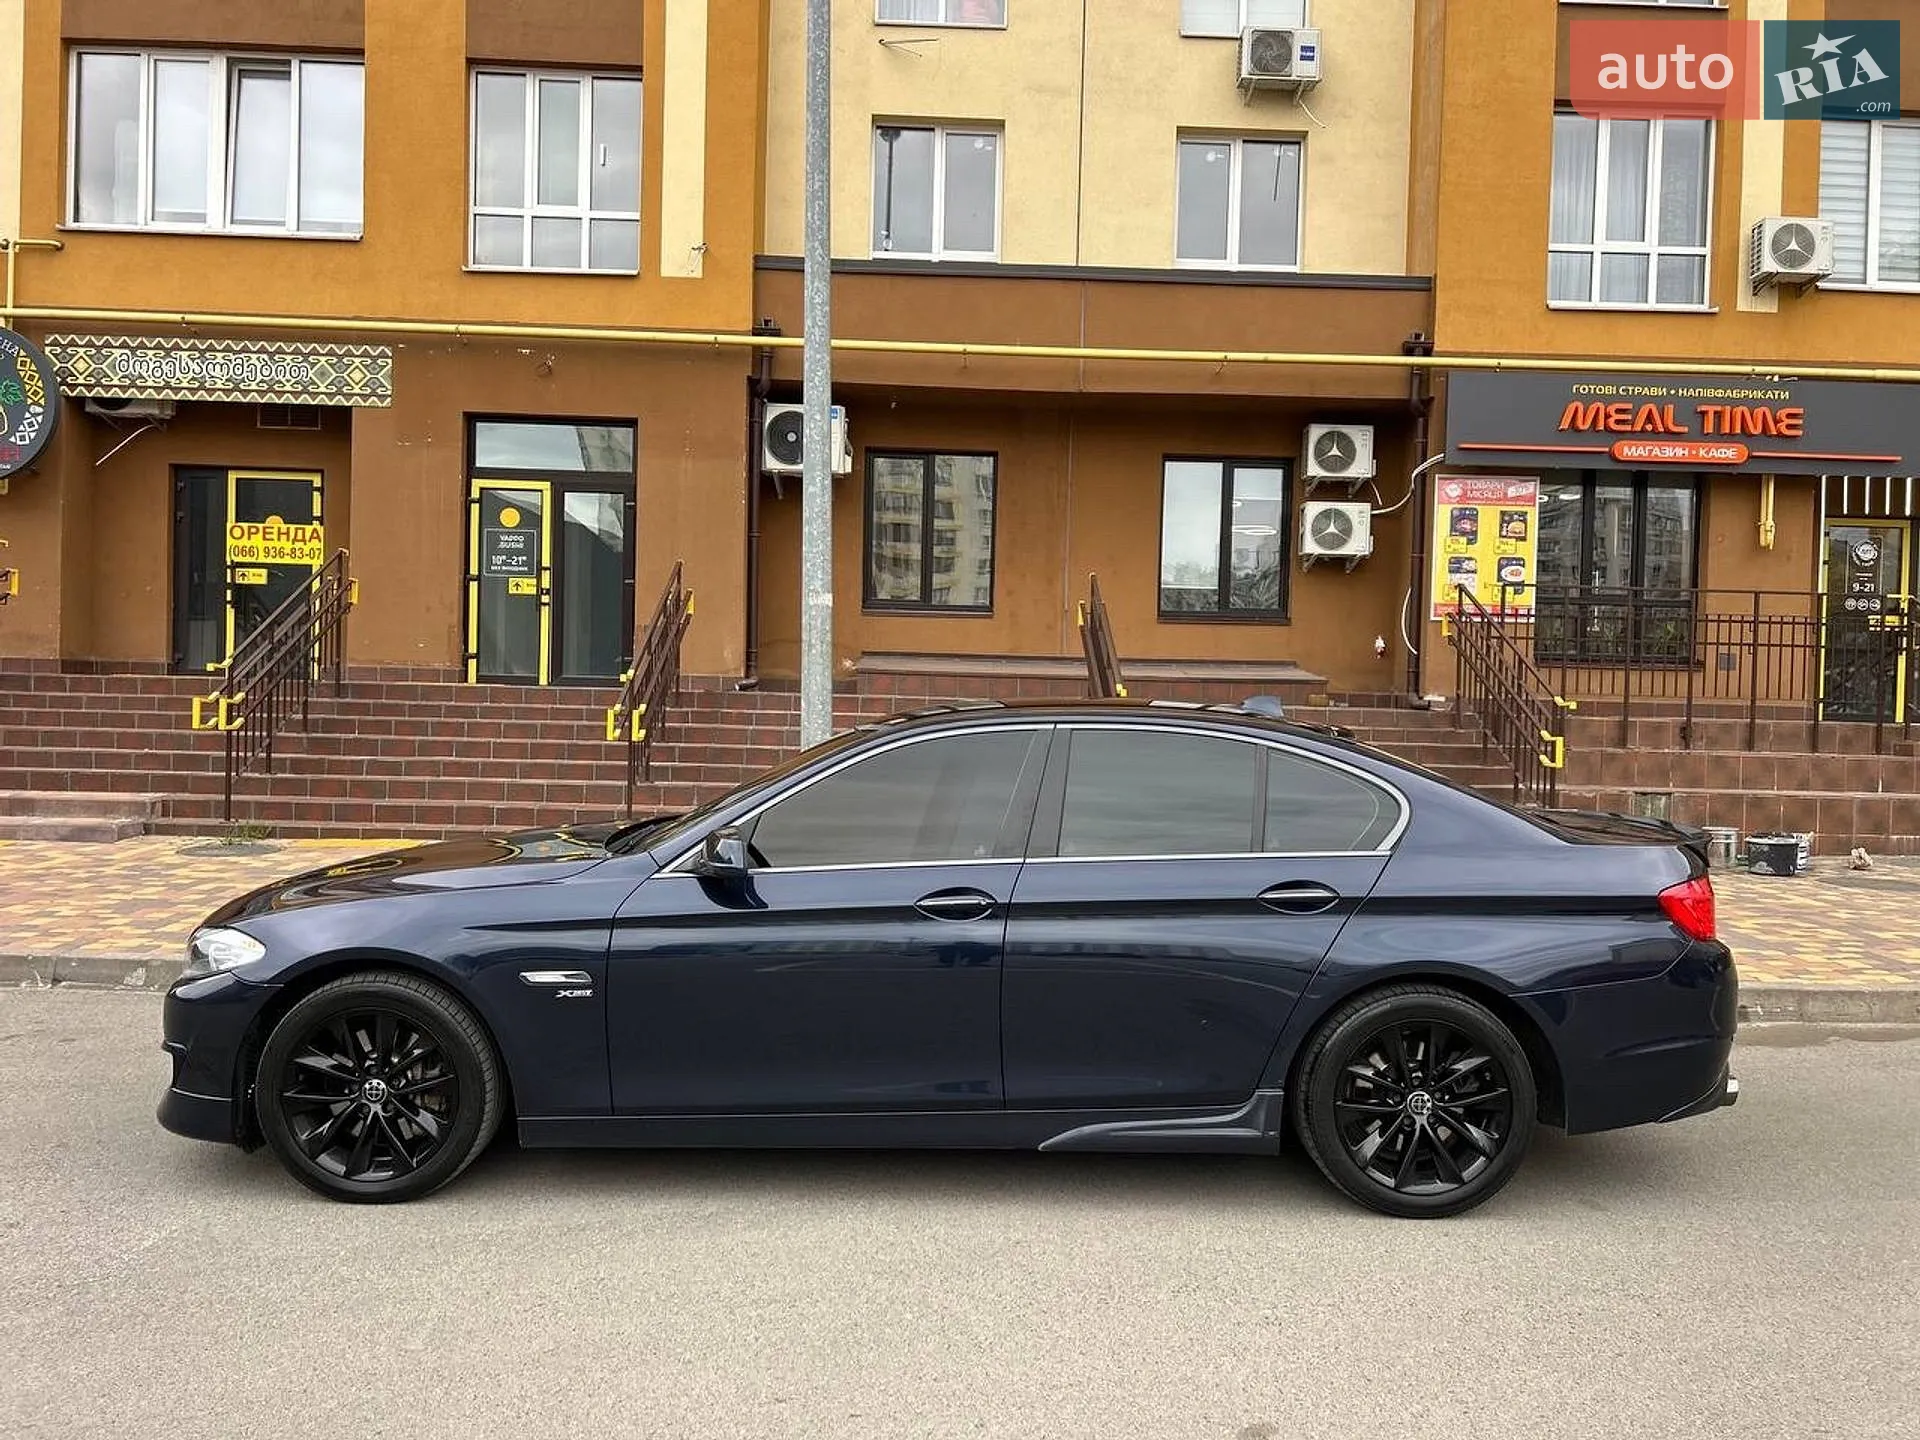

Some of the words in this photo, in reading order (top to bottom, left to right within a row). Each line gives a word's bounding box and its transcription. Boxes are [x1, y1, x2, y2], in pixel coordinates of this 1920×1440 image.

[1572, 384, 1617, 395] ГОТОВІ
[1619, 385, 1667, 396] СТРАВИ
[1679, 388, 1790, 400] НАПІВФАБРИКАТИ
[1558, 400, 1689, 434] MEAL
[1696, 404, 1805, 437] TIME
[1623, 445, 1689, 457] МАГАЗИН
[1699, 447, 1738, 459] КАФЕ
[229, 525, 321, 545] ОРЕНДА
[229, 545, 259, 560] (066)
[263, 546, 322, 560] 936-83-07
[1852, 582, 1875, 592] 9-21
